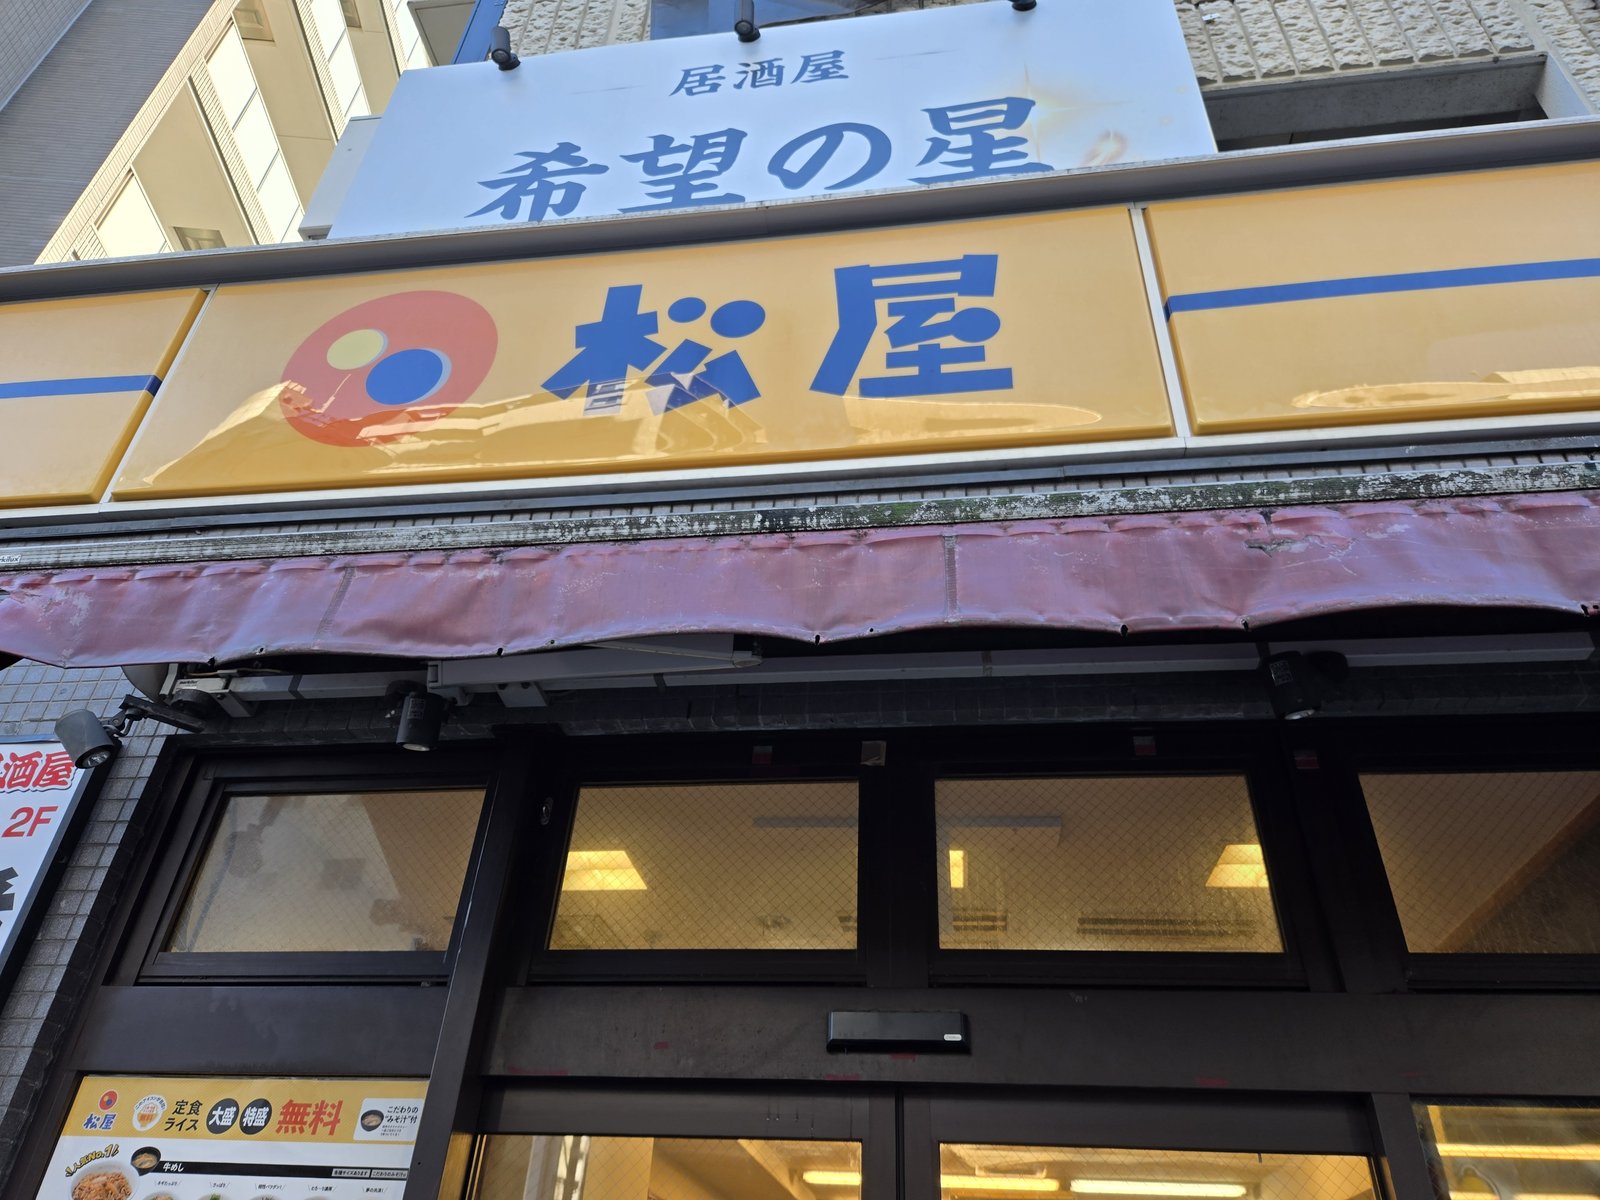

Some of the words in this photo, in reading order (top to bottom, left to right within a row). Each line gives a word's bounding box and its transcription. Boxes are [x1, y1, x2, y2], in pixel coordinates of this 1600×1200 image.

[669, 50, 850, 97] 居酒屋
[467, 96, 1055, 222] 希望の星
[541, 254, 1013, 416] 松屋
[0, 750, 75, 790] 酒屋
[2, 805, 59, 838] 2F
[172, 1100, 203, 1116] 定食
[208, 1106, 237, 1127] 大盛
[242, 1107, 269, 1127] 特盛
[275, 1099, 343, 1136] 無料
[387, 1105, 419, 1114] こだわりの
[83, 1113, 117, 1130] 松屋
[164, 1117, 199, 1132] ライス
[163, 1162, 184, 1172] 牛めし
